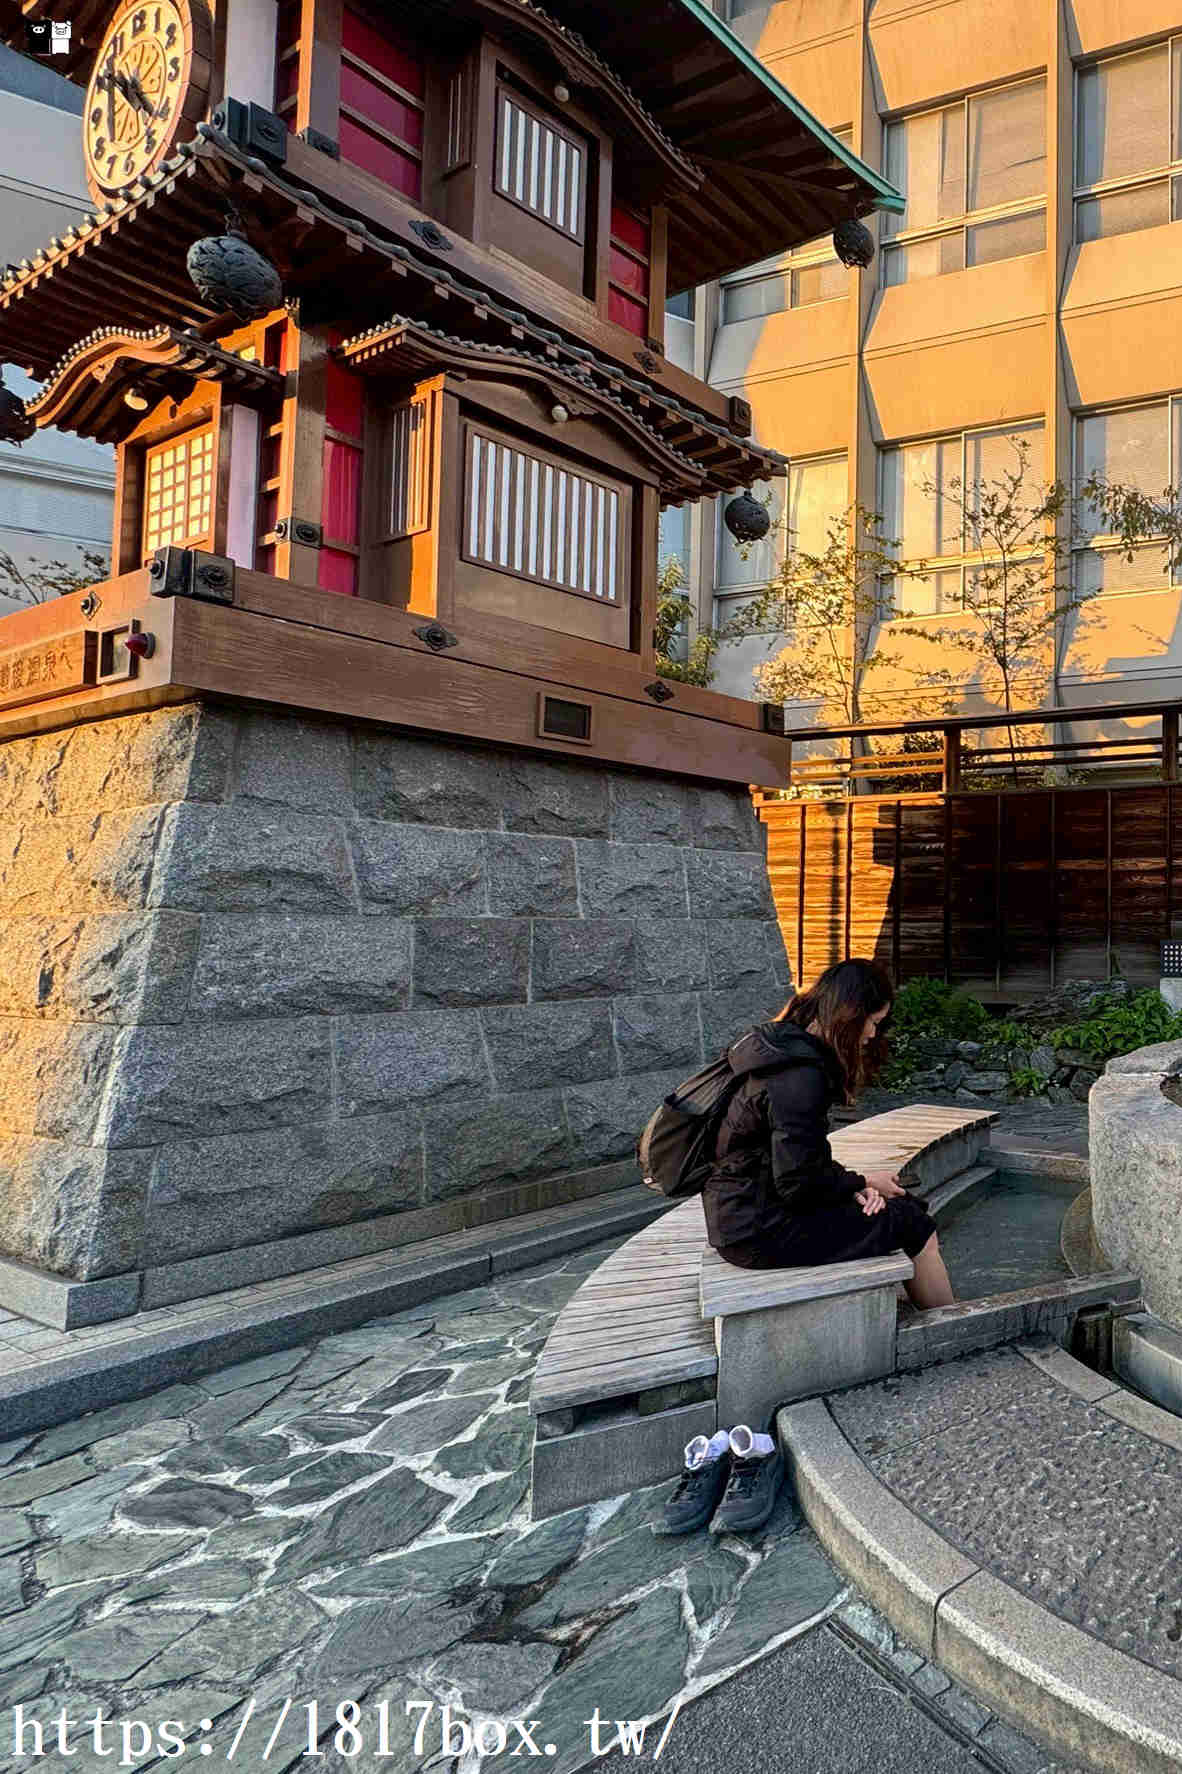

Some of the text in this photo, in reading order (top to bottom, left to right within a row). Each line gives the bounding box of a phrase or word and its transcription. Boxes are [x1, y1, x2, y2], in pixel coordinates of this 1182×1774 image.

[132, 9, 147, 38] 12
[154, 7, 161, 33] 1
[111, 32, 124, 57] 11
[166, 23, 177, 49] 2
[168, 57, 180, 82] 3
[92, 107, 103, 130] 9
[94, 136, 105, 160] 8
[106, 154, 118, 179] 7
[124, 151, 135, 176] 6
